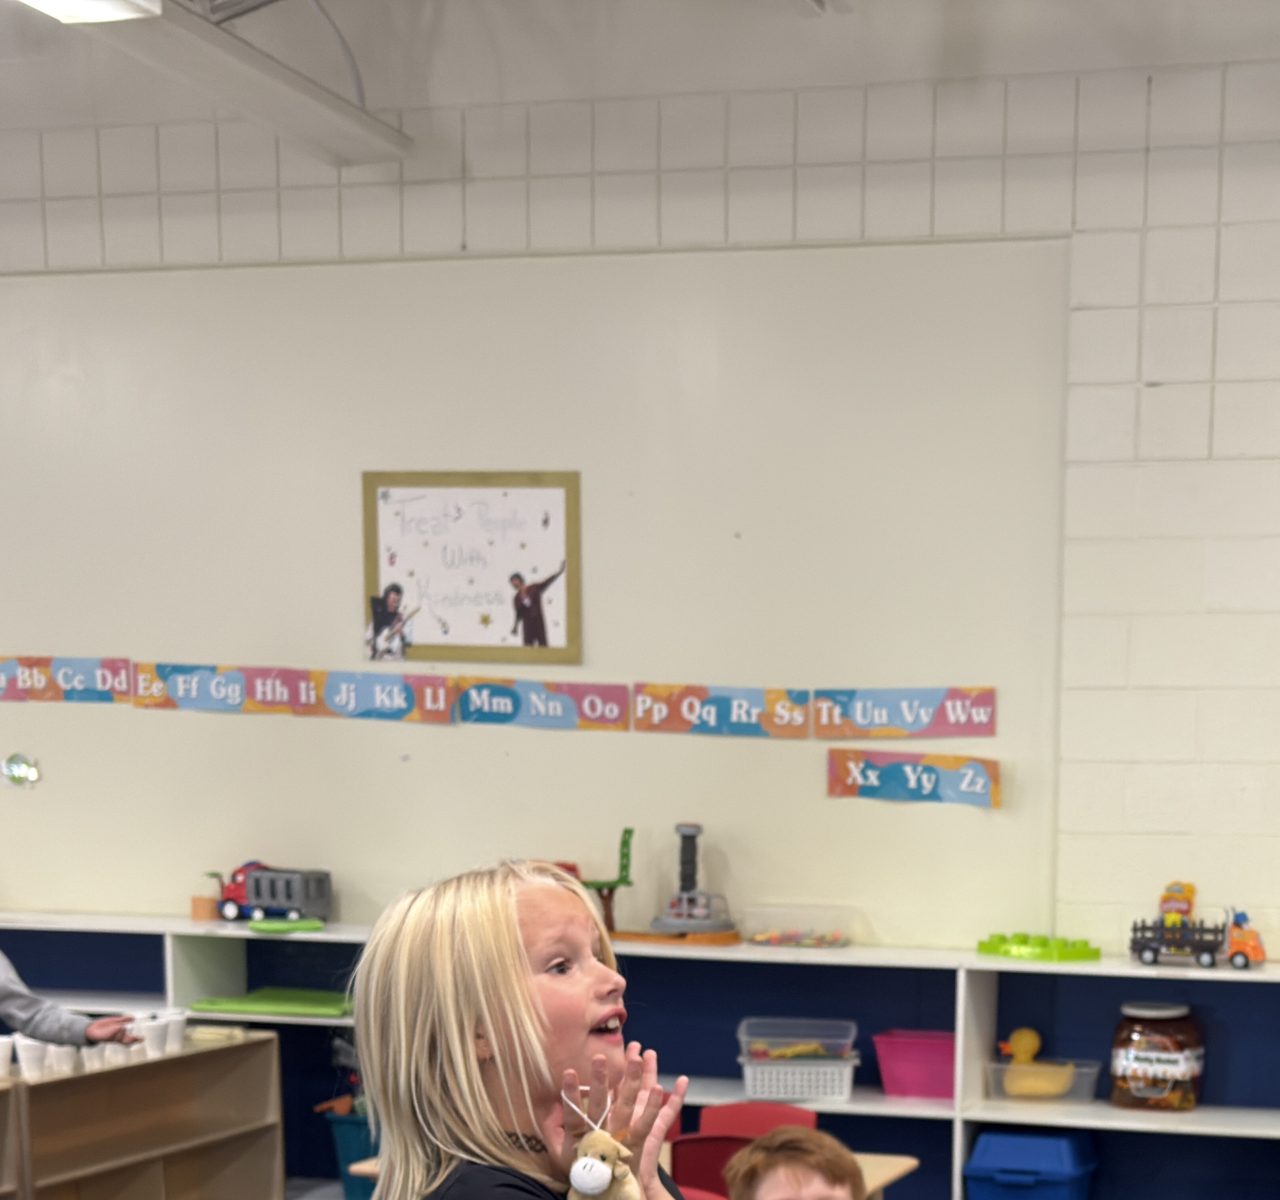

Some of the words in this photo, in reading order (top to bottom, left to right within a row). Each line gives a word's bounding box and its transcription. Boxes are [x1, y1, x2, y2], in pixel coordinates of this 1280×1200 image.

[16, 667, 46, 689] Bb
[58, 668, 85, 690] Cc
[95, 669, 128, 691] Dd
[138, 675, 164, 696] Ee
[176, 674, 198, 698] Ff
[210, 678, 242, 704] Gg
[255, 678, 289, 702] Hh
[300, 681, 316, 705] Ii
[336, 682, 355, 711] Jj
[374, 685, 407, 709] Kk
[424, 687, 445, 711] Ll
[469, 688, 513, 714] Mm
[528, 691, 563, 717] Nn
[582, 695, 620, 719] Oo
[636, 695, 668, 724] Pp
[681, 696, 717, 727] Qq
[731, 701, 760, 724] Rr
[774, 702, 804, 726] Ss
[817, 702, 842, 725] Tt
[854, 701, 889, 725] Uu
[901, 700, 933, 724] Vv
[945, 699, 992, 724] Ww
[846, 761, 880, 787] Xx
[903, 764, 936, 795] Yy
[960, 769, 986, 793] Zz
